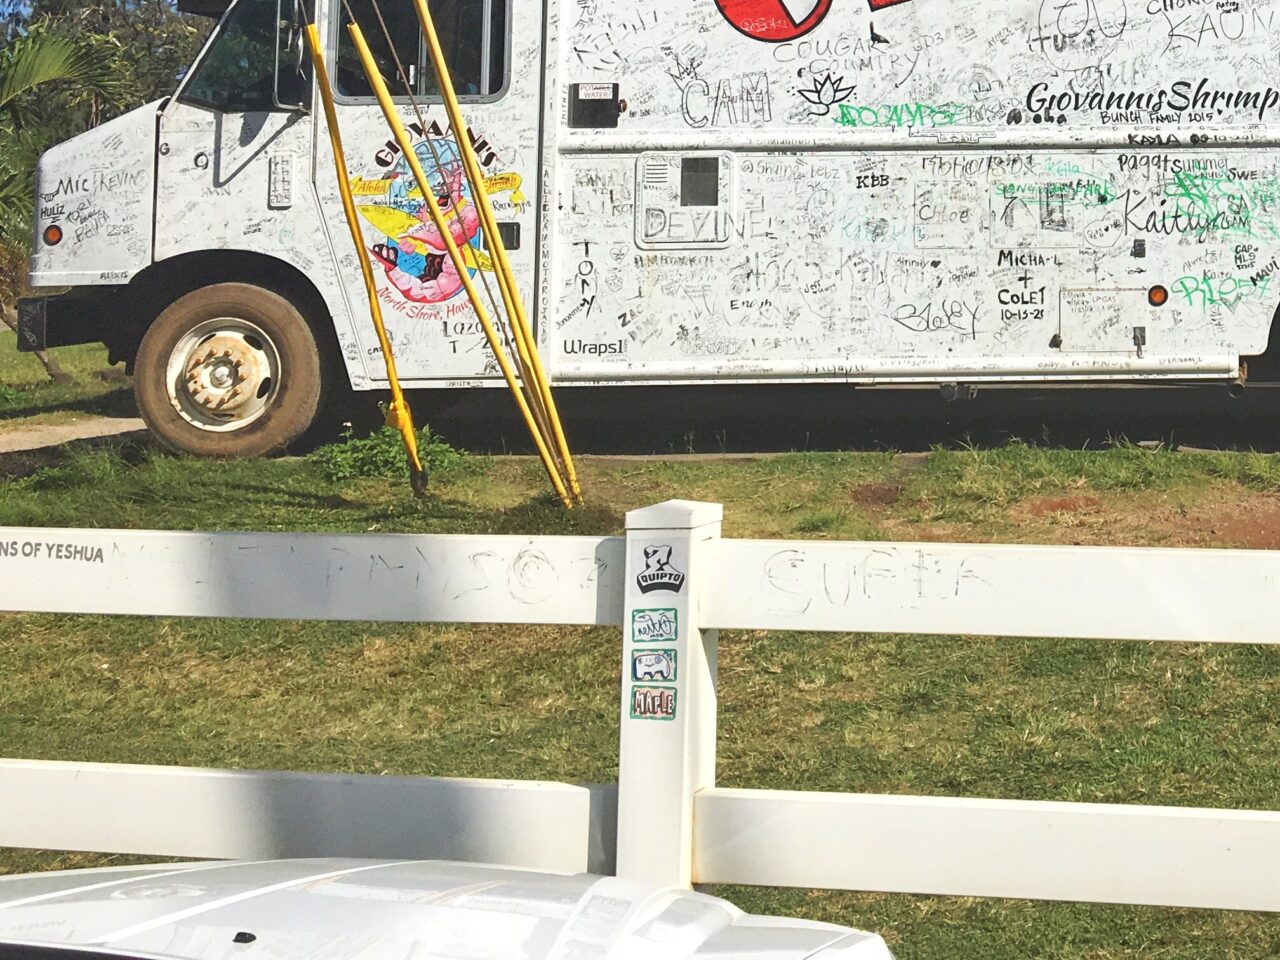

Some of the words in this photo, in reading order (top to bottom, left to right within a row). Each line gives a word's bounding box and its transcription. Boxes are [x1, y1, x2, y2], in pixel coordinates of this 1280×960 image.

[773, 38, 887, 63] COUGAR
[808, 52, 920, 88] COUNTRY
[682, 74, 772, 129] CAM
[1100, 111, 1142, 125] BUNCH
[1150, 111, 1182, 124] FAMILY
[1188, 112, 1214, 124] 2015
[374, 119, 499, 168] GIVANI'S
[357, 181, 386, 192] Aloha
[1116, 189, 1226, 243] Kaitlyn
[1250, 256, 1280, 287] MAUI
[376, 286, 408, 312] North
[405, 304, 443, 321] Shore,
[21, 541, 42, 558] OF
[46, 542, 104, 563] YESHUA
[640, 571, 682, 583] QUIPTO
[634, 690, 674, 715] MAPLE
